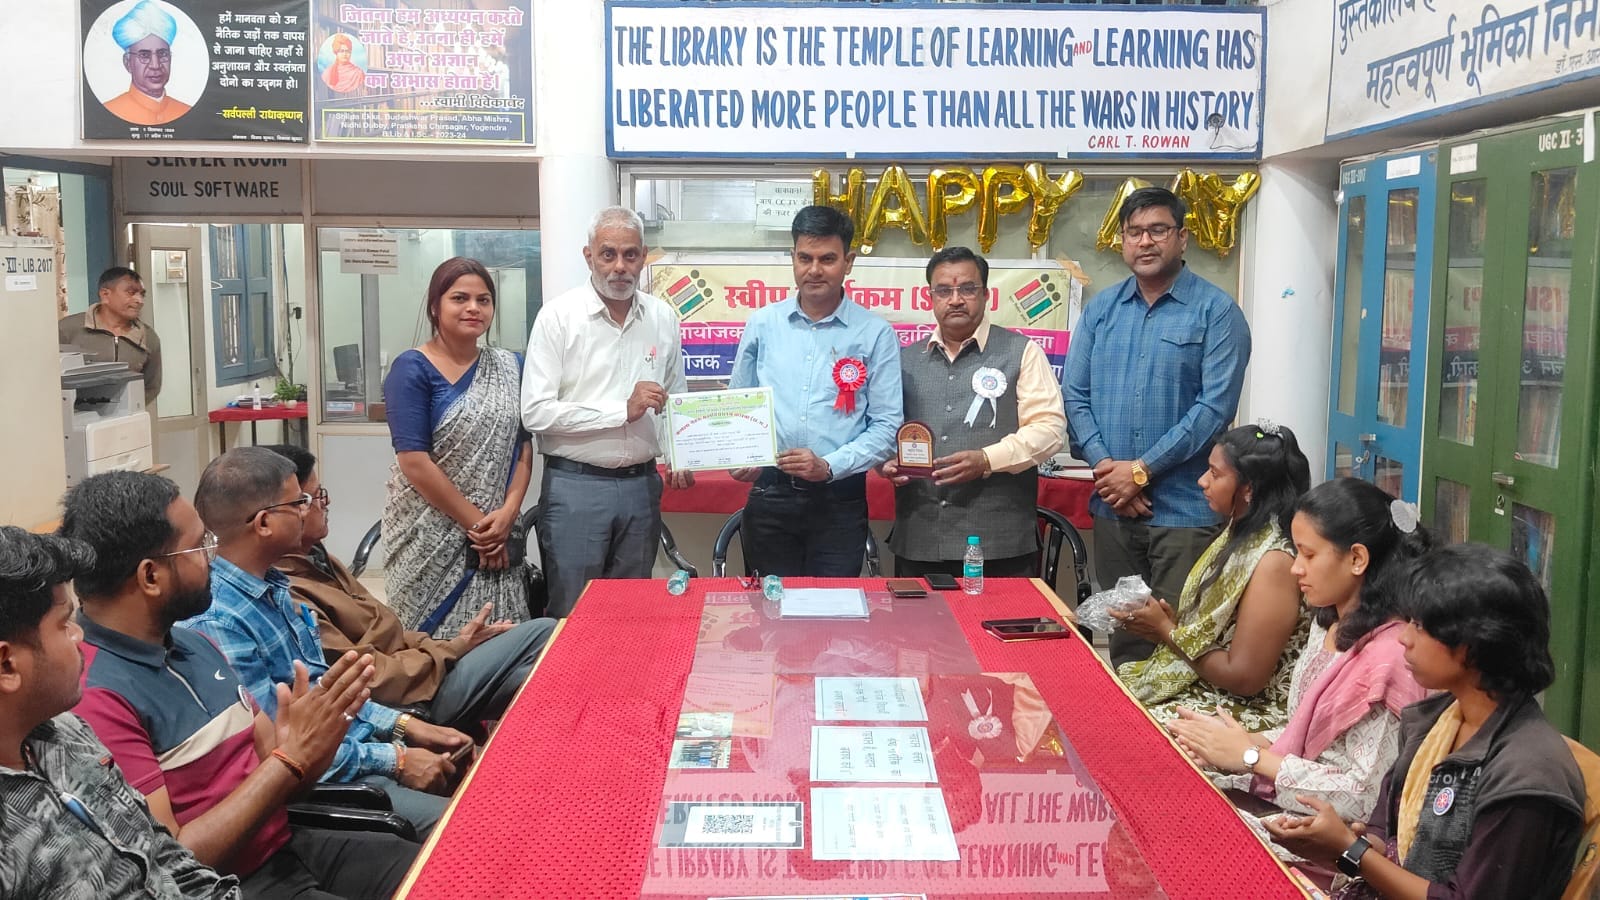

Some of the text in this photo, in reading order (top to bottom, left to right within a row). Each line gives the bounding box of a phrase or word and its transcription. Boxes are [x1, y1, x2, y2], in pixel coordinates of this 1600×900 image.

[218, 11, 298, 25] हमें मानवता को उन
[340, 5, 524, 25] जितना हम अध्ययन करते
[215, 27, 305, 41] नैतिक जड़ों तक वापस
[359, 26, 394, 45] जाते
[415, 31, 456, 45] उतना
[459, 27, 477, 46] ही
[479, 28, 505, 46] हमें
[213, 42, 304, 57] ले जाना चाहिए जहाँ से
[615, 26, 1256, 70] THE LIBRARY IS THE TEMPLE OF LEARNING AND LEARNING HAS
[1461, 4, 1538, 95] भूमिका
[211, 62, 251, 75] अनुशासन
[254, 59, 271, 72] और
[386, 49, 479, 68] अपने अज्ञान
[241, 79, 254, 88] का
[256, 79, 283, 91] उद्गम
[365, 74, 389, 88] का
[391, 74, 440, 89] अभास
[443, 71, 478, 90] होता
[616, 89, 1254, 131] LIBERATED MORE PEOPLE THAN ALL THE WARS IN HISTORY
[471, 124, 507, 132] Yogendra
[1088, 135, 1190, 149] CARL T. ROWAN
[1539, 133, 1557, 152] UGC
[150, 181, 279, 198] SOUL SOFTWARE
[812, 162, 1083, 253] HAPPY
[724, 279, 790, 309] स्वीप
